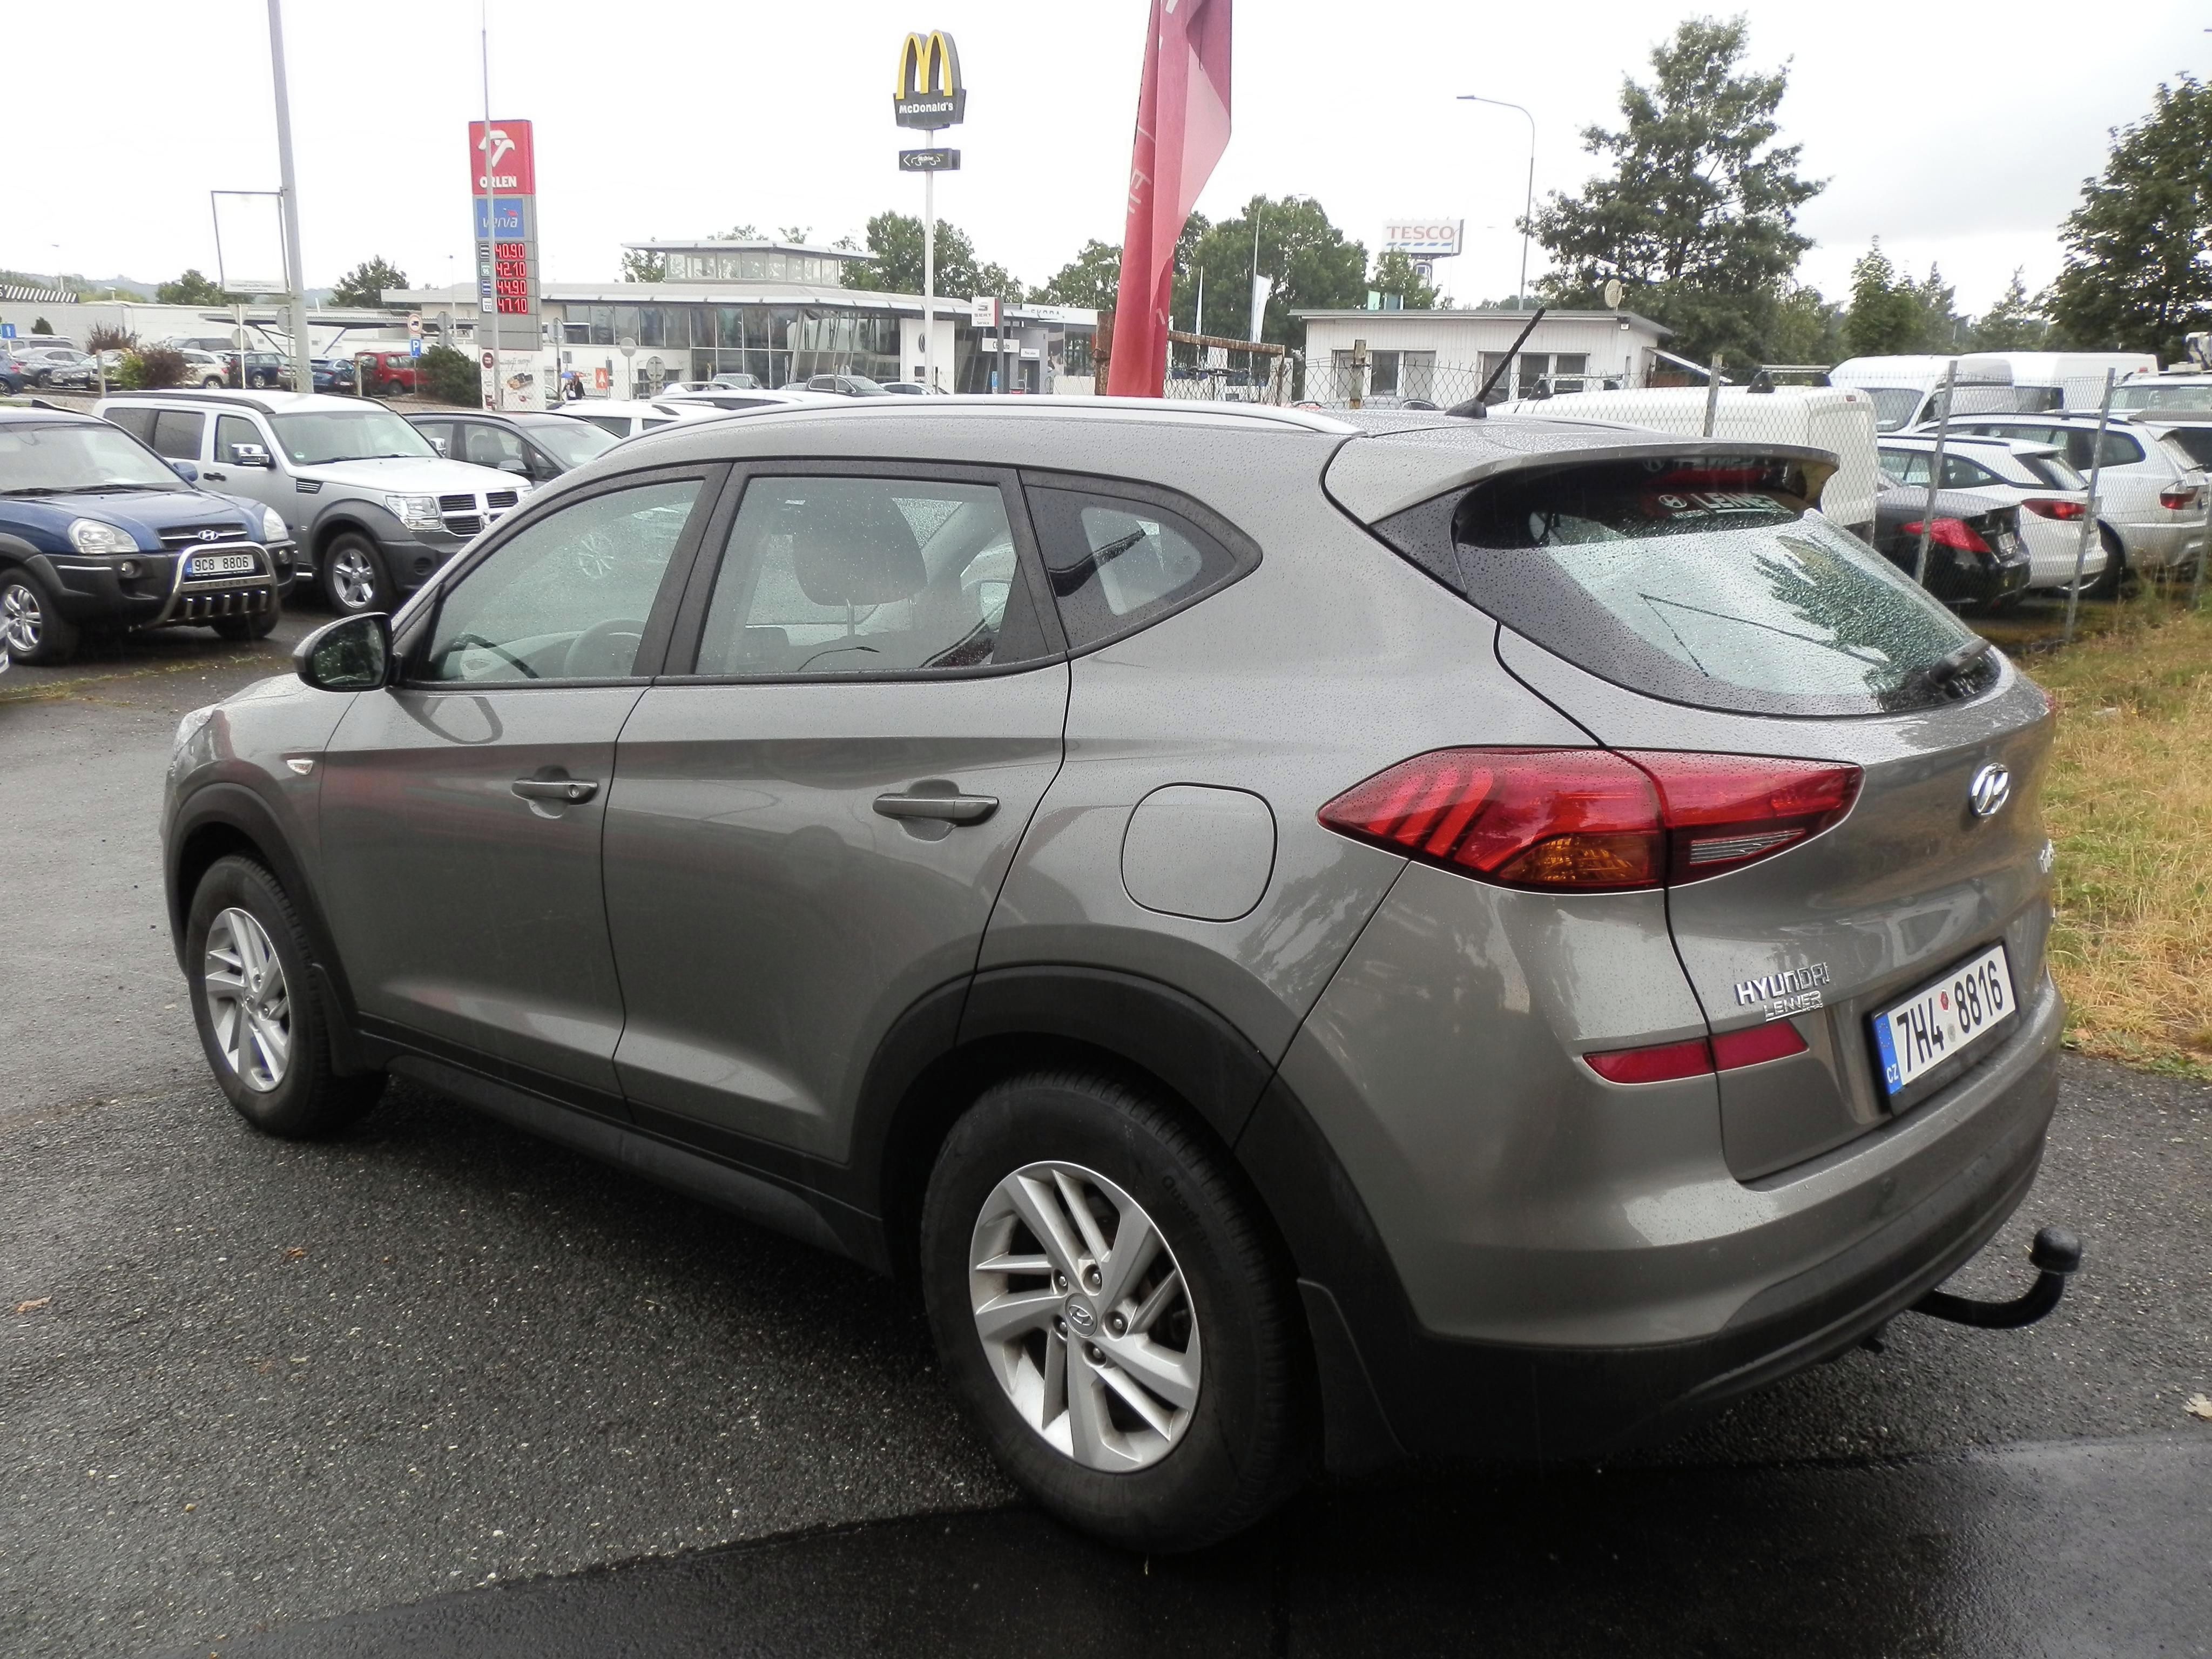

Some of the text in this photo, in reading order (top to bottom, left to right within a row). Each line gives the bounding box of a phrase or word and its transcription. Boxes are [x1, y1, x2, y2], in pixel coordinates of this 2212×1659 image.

[899, 102, 954, 114] McDonald's
[480, 176, 517, 188] ORLEN
[1386, 226, 1455, 240] TESCO
[413, 340, 420, 352] P
[194, 557, 249, 571] 9C8 8806
[1735, 962, 1830, 1006] HYUNDAI
[1896, 960, 2003, 1073] 7H4 8816
[1886, 1063, 1899, 1084] CZ
